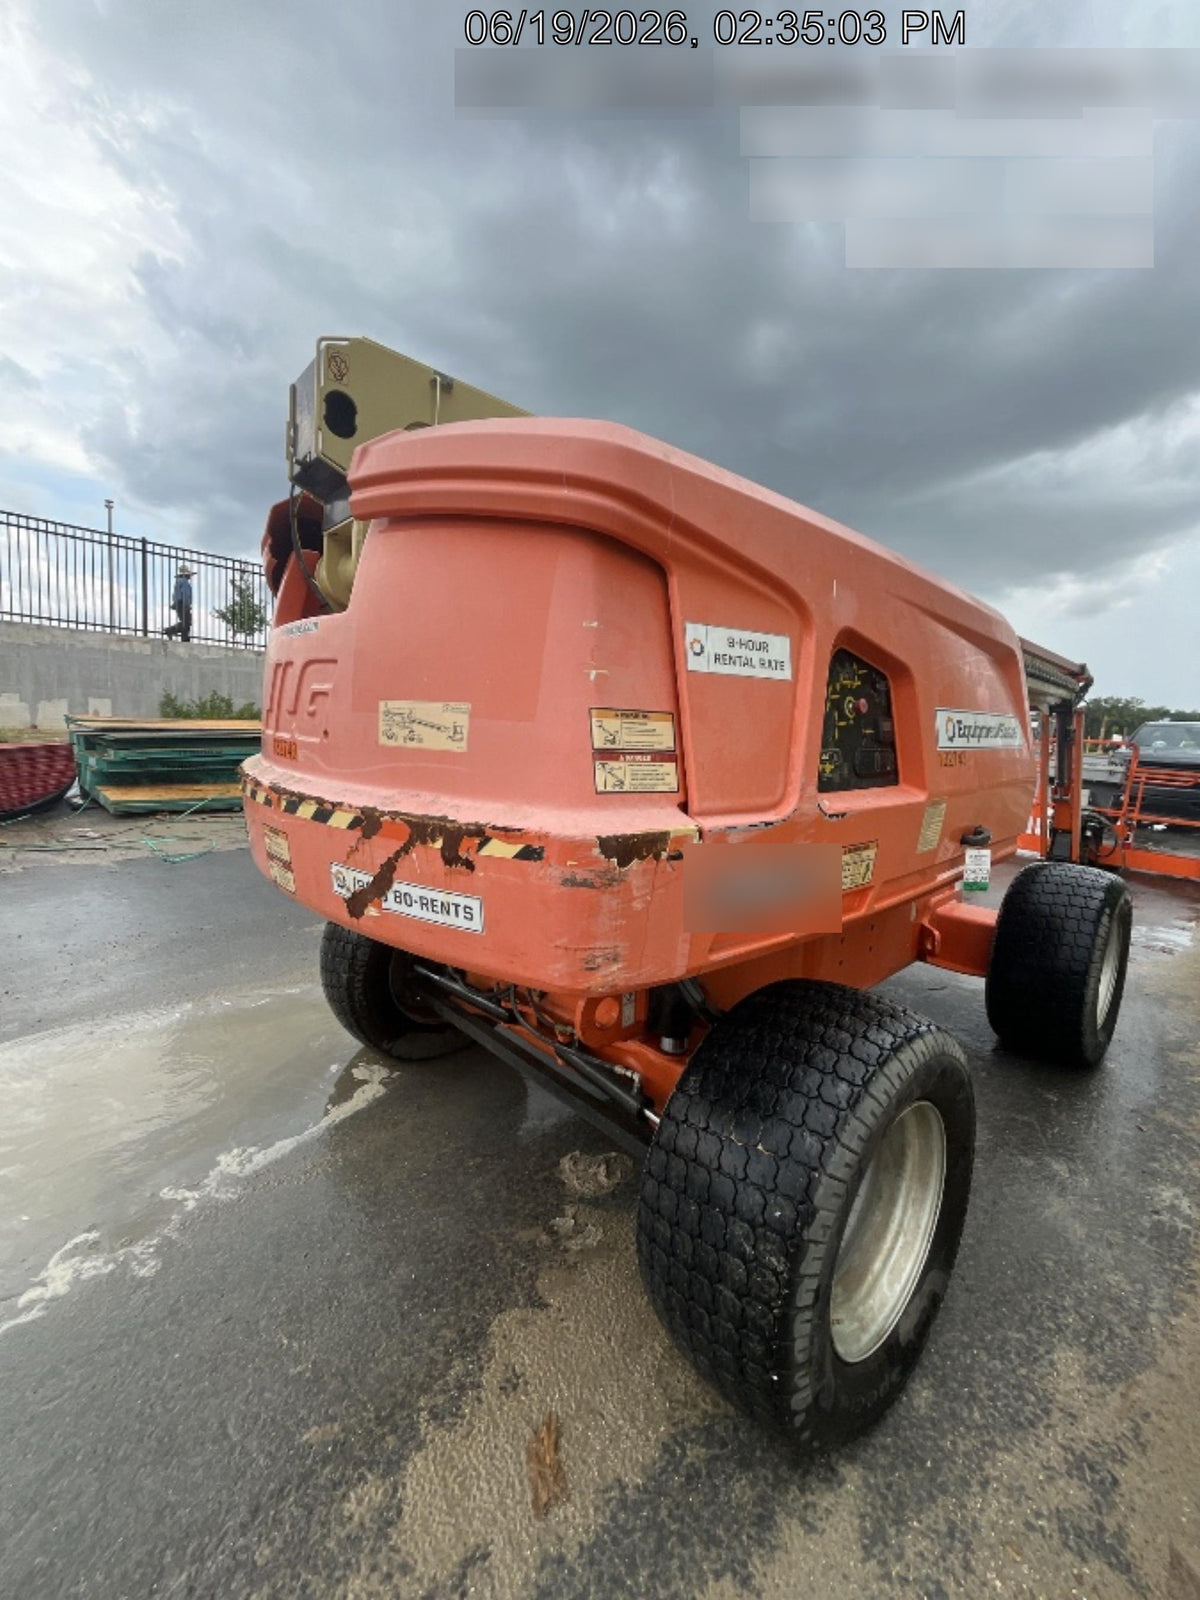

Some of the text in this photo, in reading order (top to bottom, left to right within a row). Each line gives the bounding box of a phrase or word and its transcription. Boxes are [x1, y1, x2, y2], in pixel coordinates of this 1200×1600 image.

[727, 636, 769, 653] 8-HOUR
[714, 652, 785, 671] RENTAL RATE
[394, 890, 474, 922] 80-RENTS
